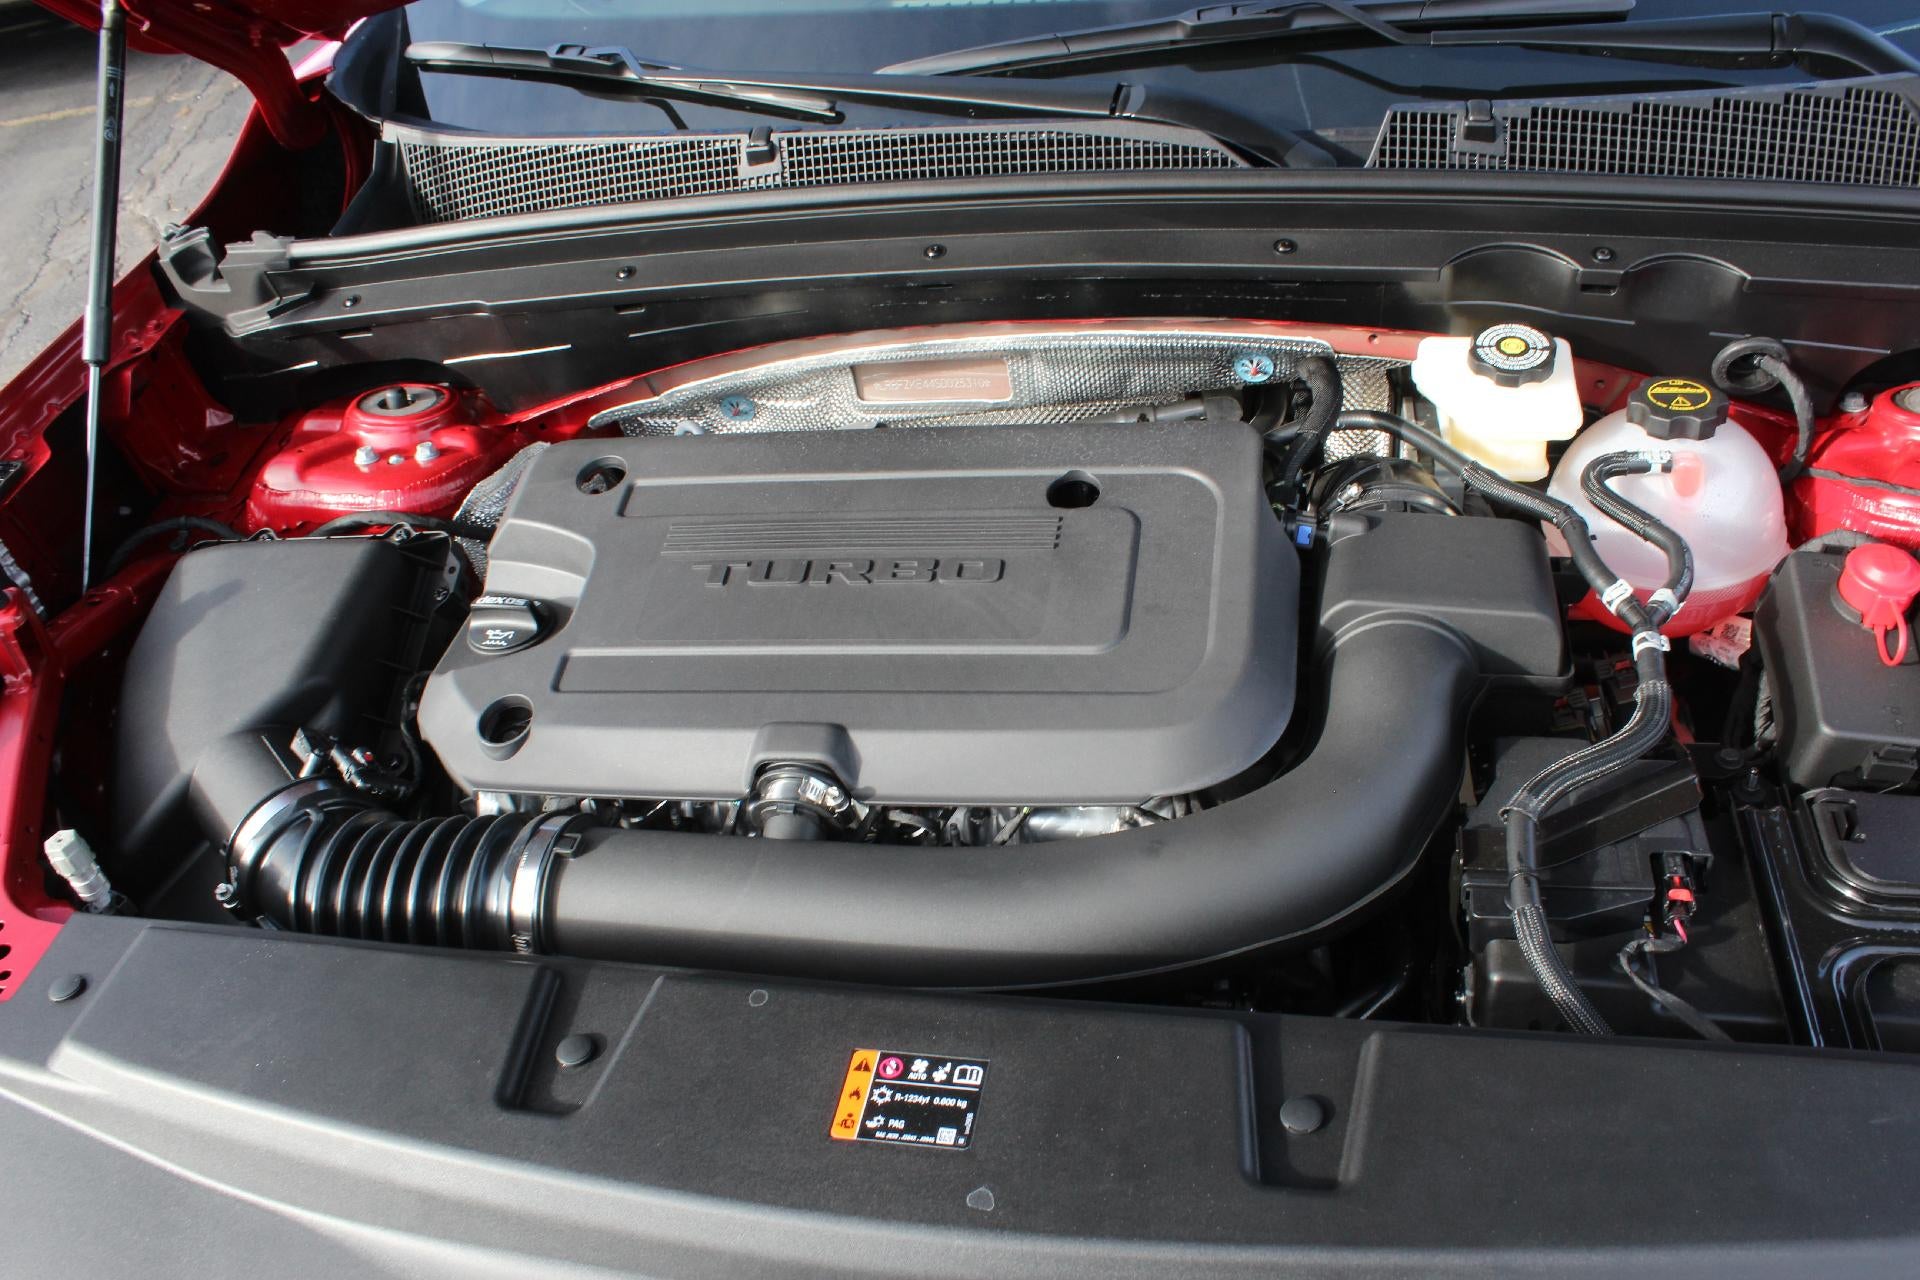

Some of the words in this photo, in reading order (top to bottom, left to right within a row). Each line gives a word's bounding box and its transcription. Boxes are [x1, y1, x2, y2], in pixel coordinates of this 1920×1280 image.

[692, 558, 1006, 587] TURBO
[476, 596, 529, 606] dexos
[908, 1072, 927, 1080] AUTO
[894, 1093, 930, 1105] R-1234yf
[957, 1098, 968, 1109] kg
[888, 1119, 905, 1129] PAG
